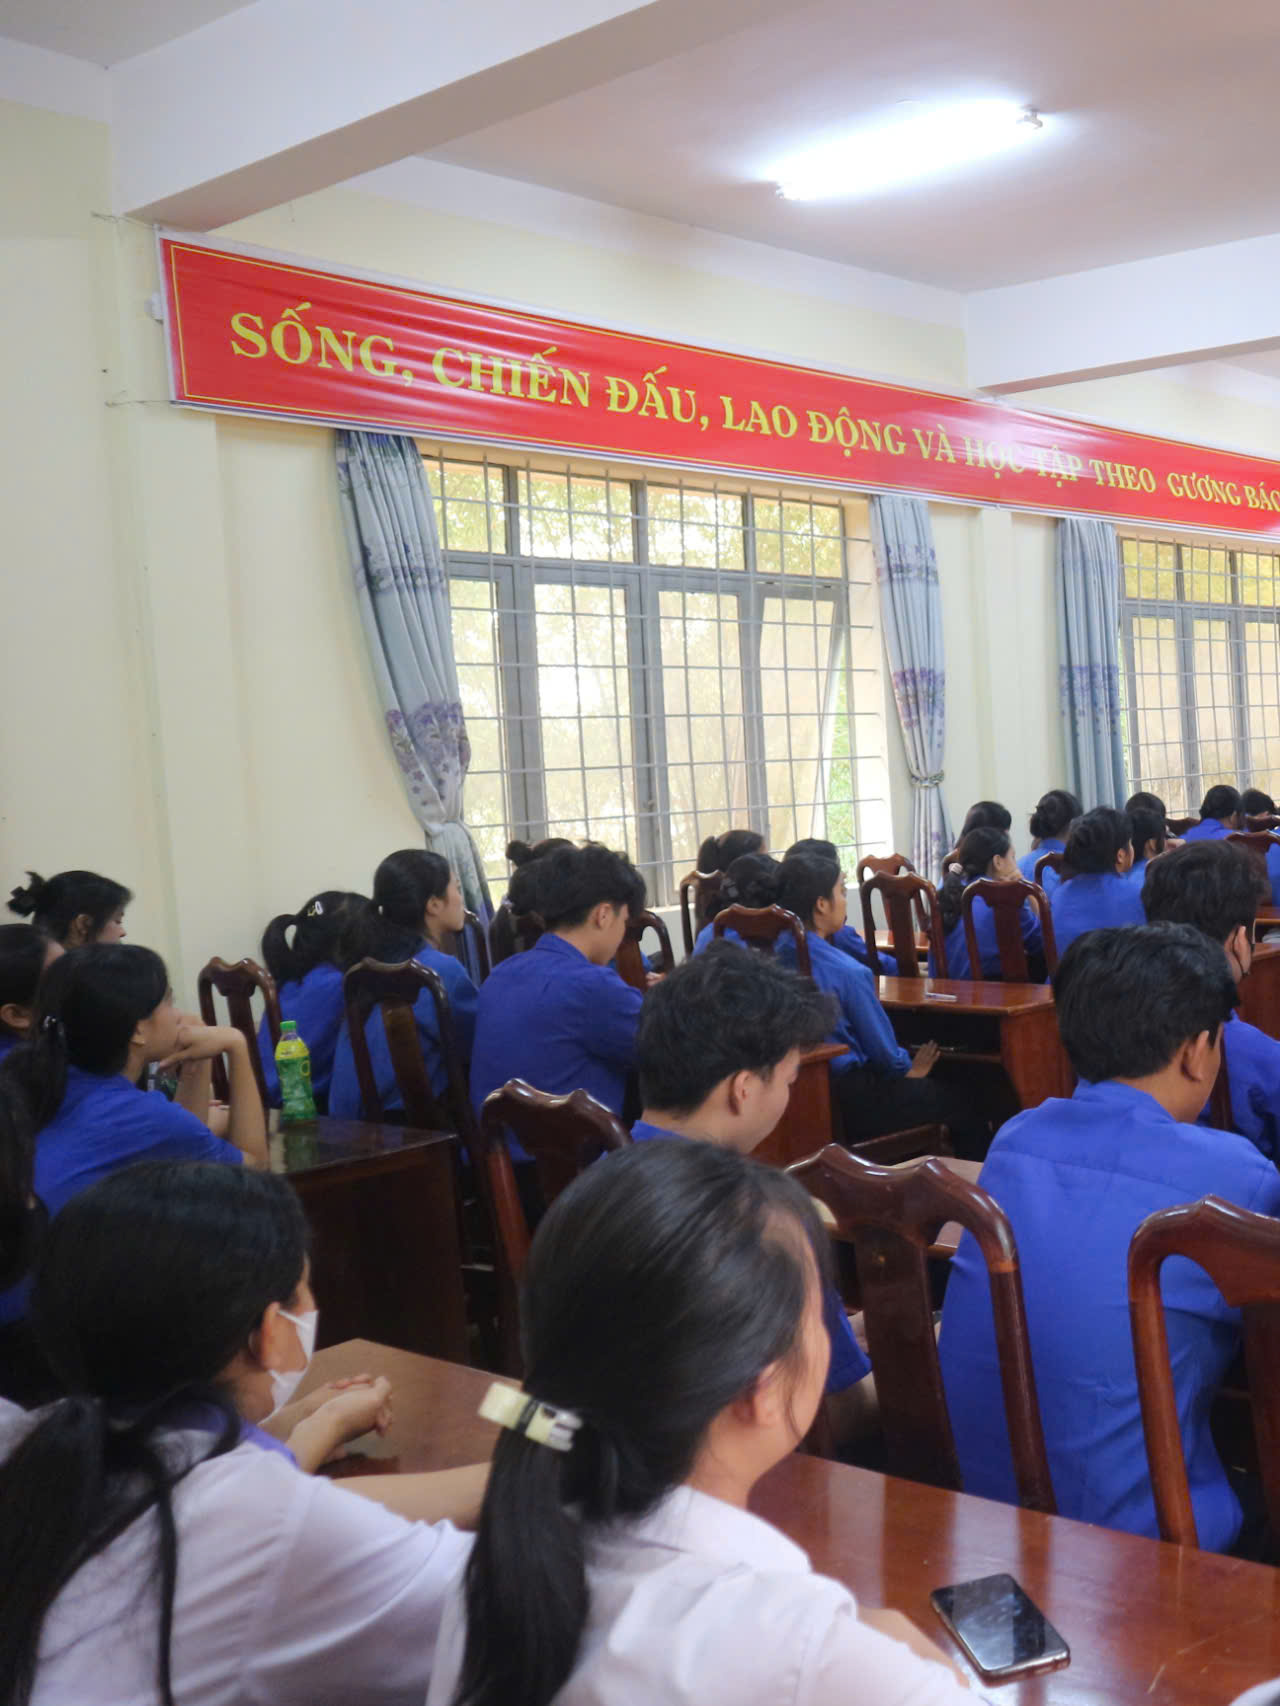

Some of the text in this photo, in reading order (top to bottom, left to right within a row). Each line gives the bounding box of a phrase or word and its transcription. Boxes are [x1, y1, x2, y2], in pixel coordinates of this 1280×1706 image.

[230, 302, 414, 387] SỐNG,
[431, 346, 591, 407] CHIẾN
[604, 365, 709, 431] ĐẤU,
[719, 395, 798, 438] LAO
[806, 406, 906, 457] ĐỘNG
[912, 423, 956, 463] VÀ
[962, 436, 1025, 479] HỌC
[1031, 445, 1083, 488] TẬP
[1089, 459, 1156, 493] THEO
[1167, 473, 1241, 506] GƯƠNG
